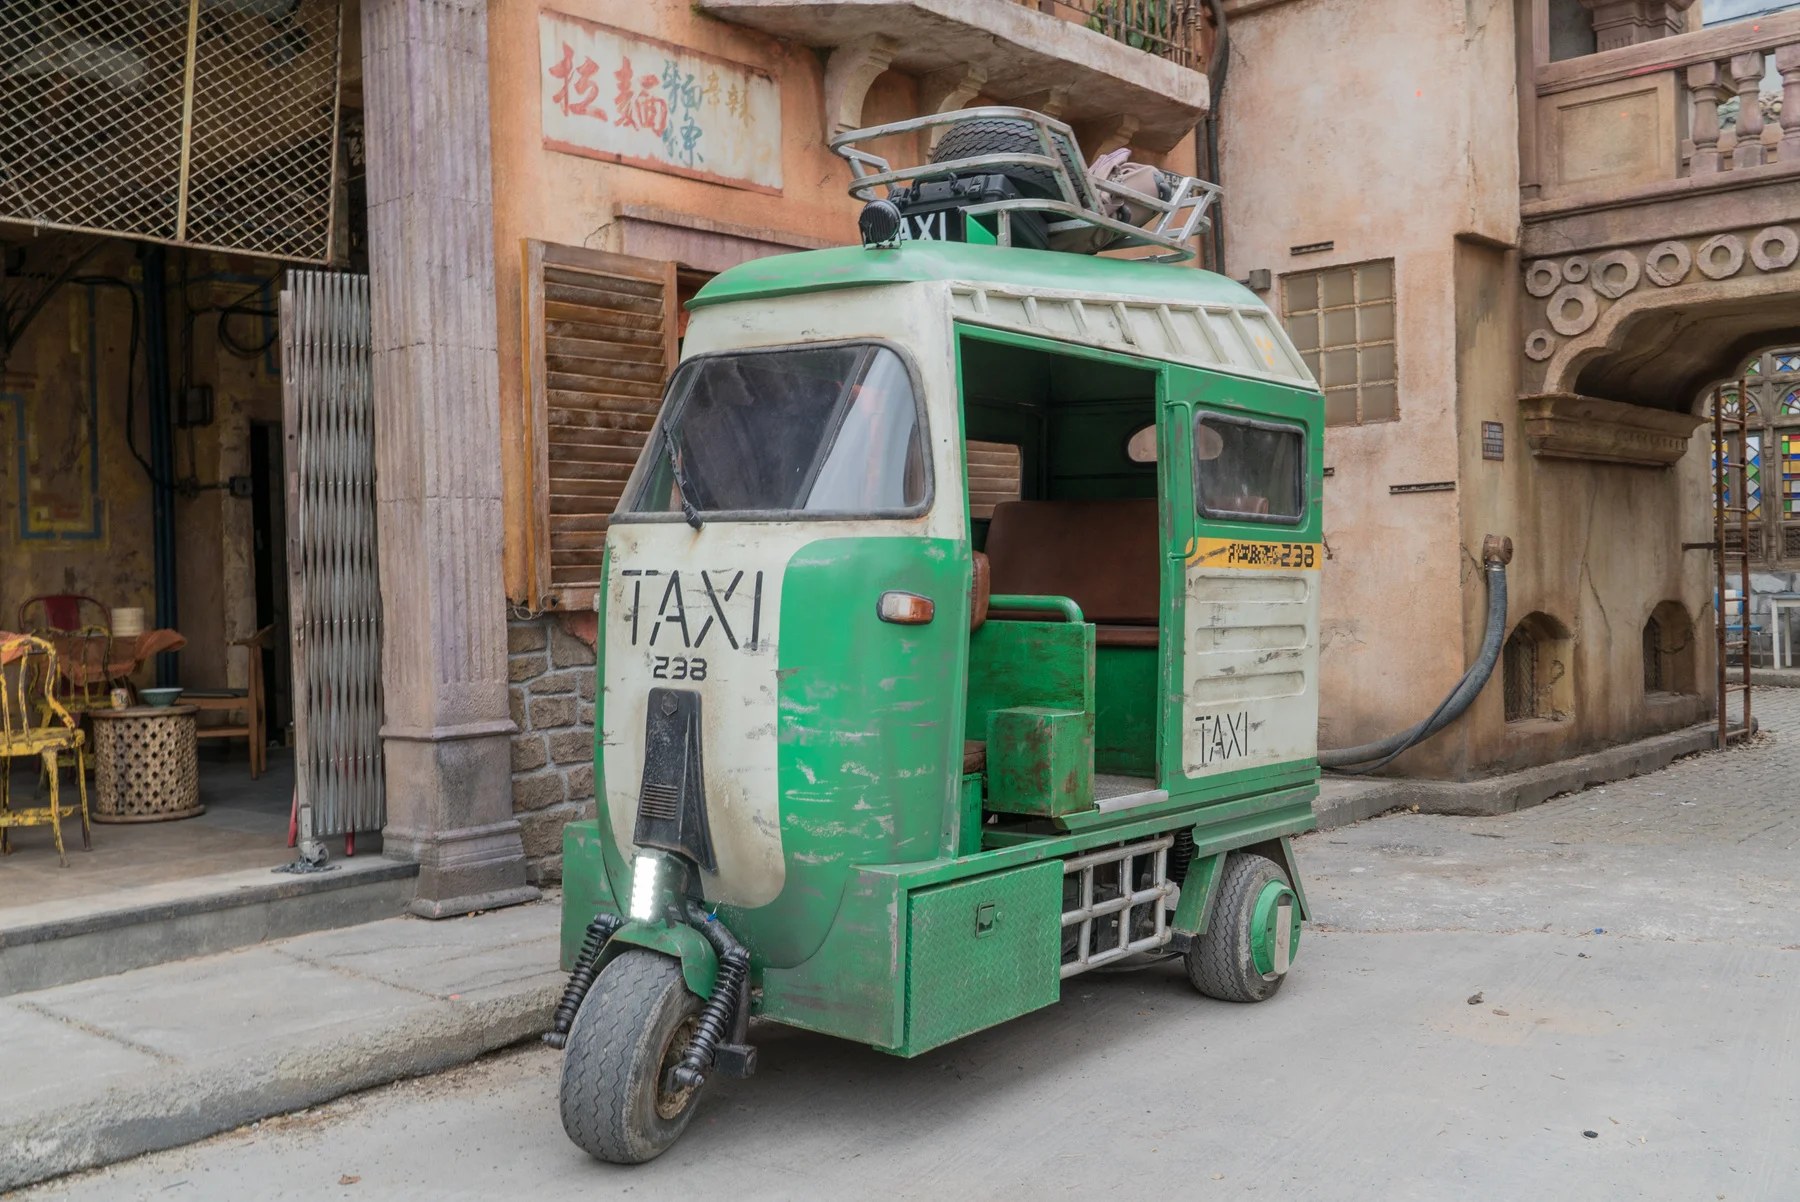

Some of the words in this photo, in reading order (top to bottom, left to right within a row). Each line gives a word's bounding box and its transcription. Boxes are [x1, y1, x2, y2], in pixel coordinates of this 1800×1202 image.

[548, 41, 668, 138] 拉麵
[895, 211, 947, 241] AXI
[1281, 543, 1314, 568] 238
[621, 569, 764, 652] TAXI
[652, 656, 708, 682] 238
[1194, 711, 1248, 764] TAXI
